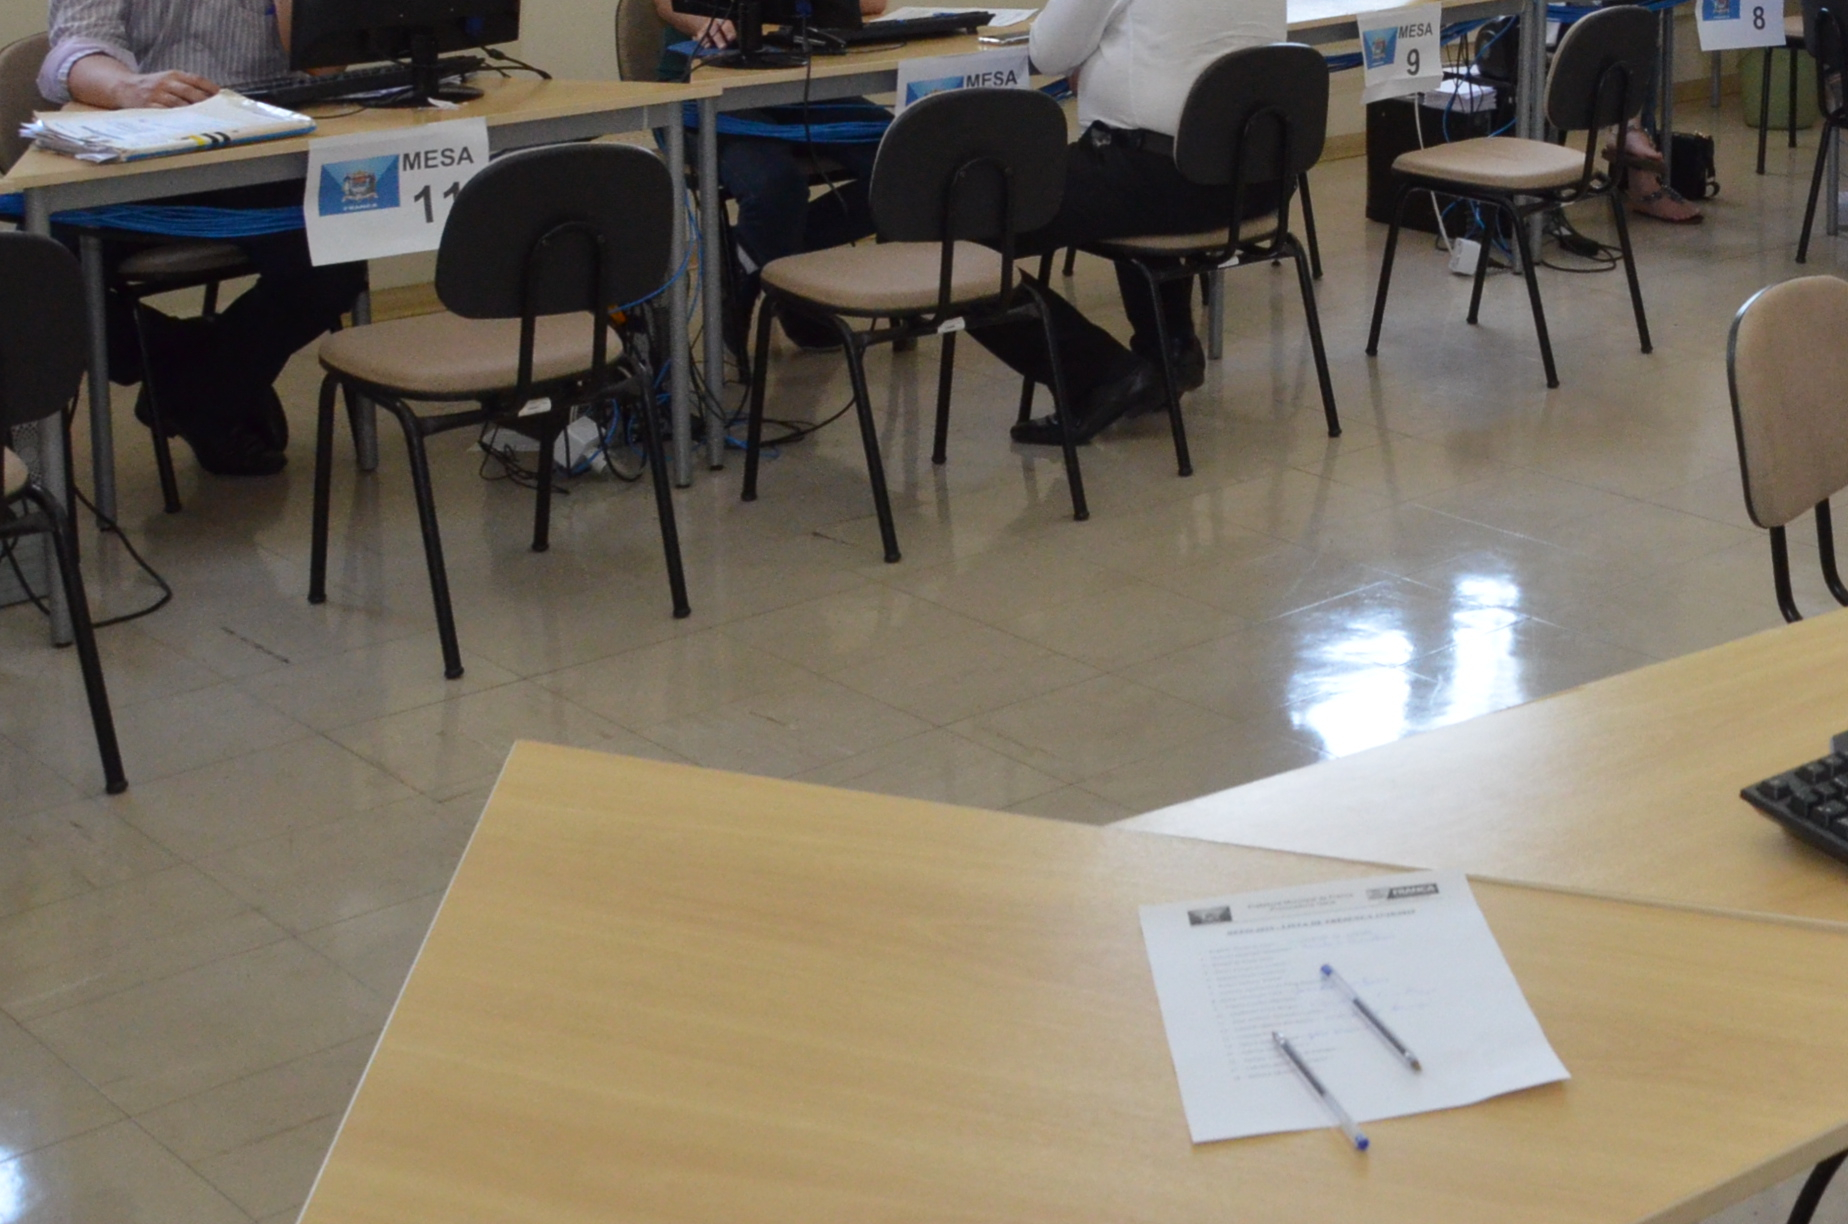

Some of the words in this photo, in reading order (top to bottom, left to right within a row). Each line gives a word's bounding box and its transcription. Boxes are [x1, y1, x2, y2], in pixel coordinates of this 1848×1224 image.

[1753, 5, 1766, 30] 8
[1399, 22, 1433, 39] MESA
[1406, 48, 1420, 76] 9
[402, 146, 474, 172] MESA
